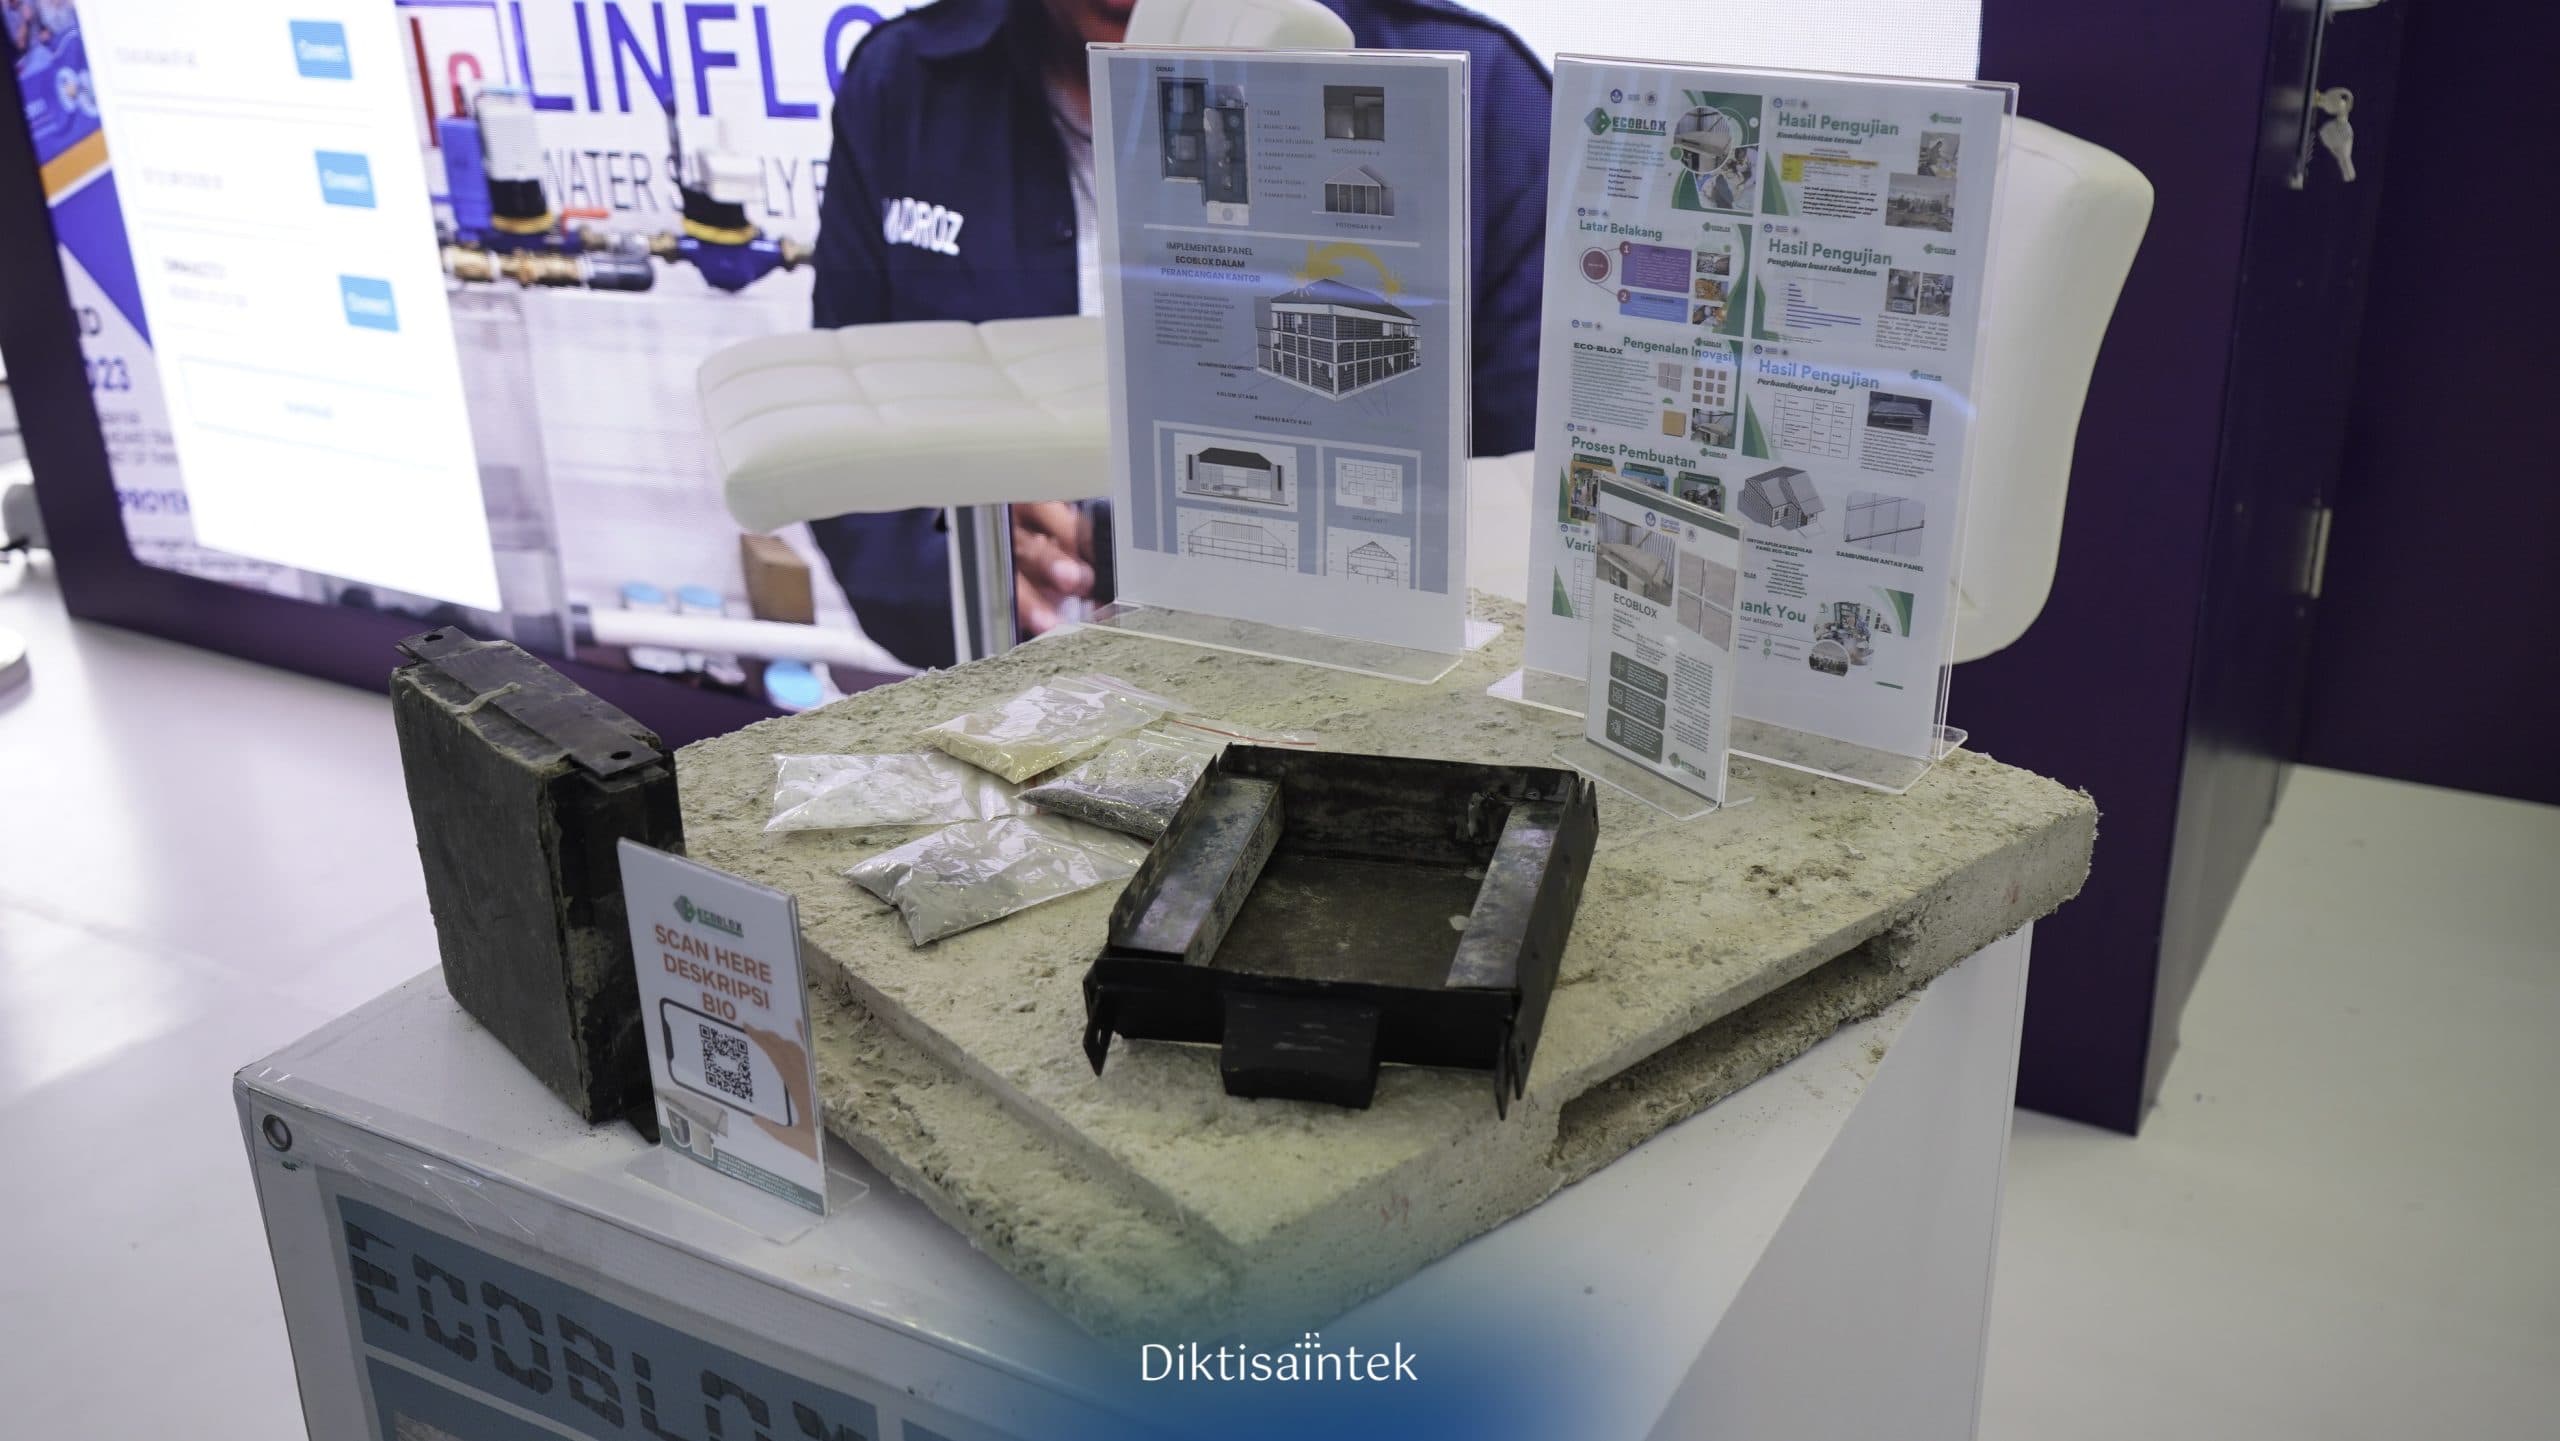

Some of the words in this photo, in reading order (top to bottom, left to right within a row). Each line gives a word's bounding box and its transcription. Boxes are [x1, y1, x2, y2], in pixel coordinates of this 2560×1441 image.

[1612, 116, 1668, 131] ECOBLOX
[1778, 111, 1816, 129] Hasil
[1820, 115, 1900, 138] Pengujian
[1579, 219, 1608, 233] Latar
[1610, 222, 1663, 241] Belakang
[1166, 241, 1226, 255] IMPLEMENTASI
[1227, 247, 1254, 256] PANEL
[1175, 255, 1214, 266] ECOBLOX
[1215, 258, 1245, 268] DALAM
[1768, 238, 1808, 256] Hasil
[1812, 242, 1892, 266] Pengujian
[1160, 267, 1225, 280] PERANCANGAN
[1225, 272, 1261, 283] KANTOR
[1573, 341, 1623, 356] ECO-BLOX
[1623, 336, 1688, 357] Pengenalan
[1690, 346, 1733, 363] Inovasi
[1758, 358, 1797, 378] Hasil
[1801, 364, 1880, 390] Pengujian
[1571, 435, 1616, 456] Proses
[1618, 443, 1697, 470] Pembuatan
[1613, 592, 1659, 619] ECOBLOX
[1776, 604, 1807, 623] You
[653, 923, 709, 961] SCAN
[714, 945, 773, 985] HERE
[663, 952, 770, 1009] DESKRIPSI
[701, 991, 737, 1021] BIO
